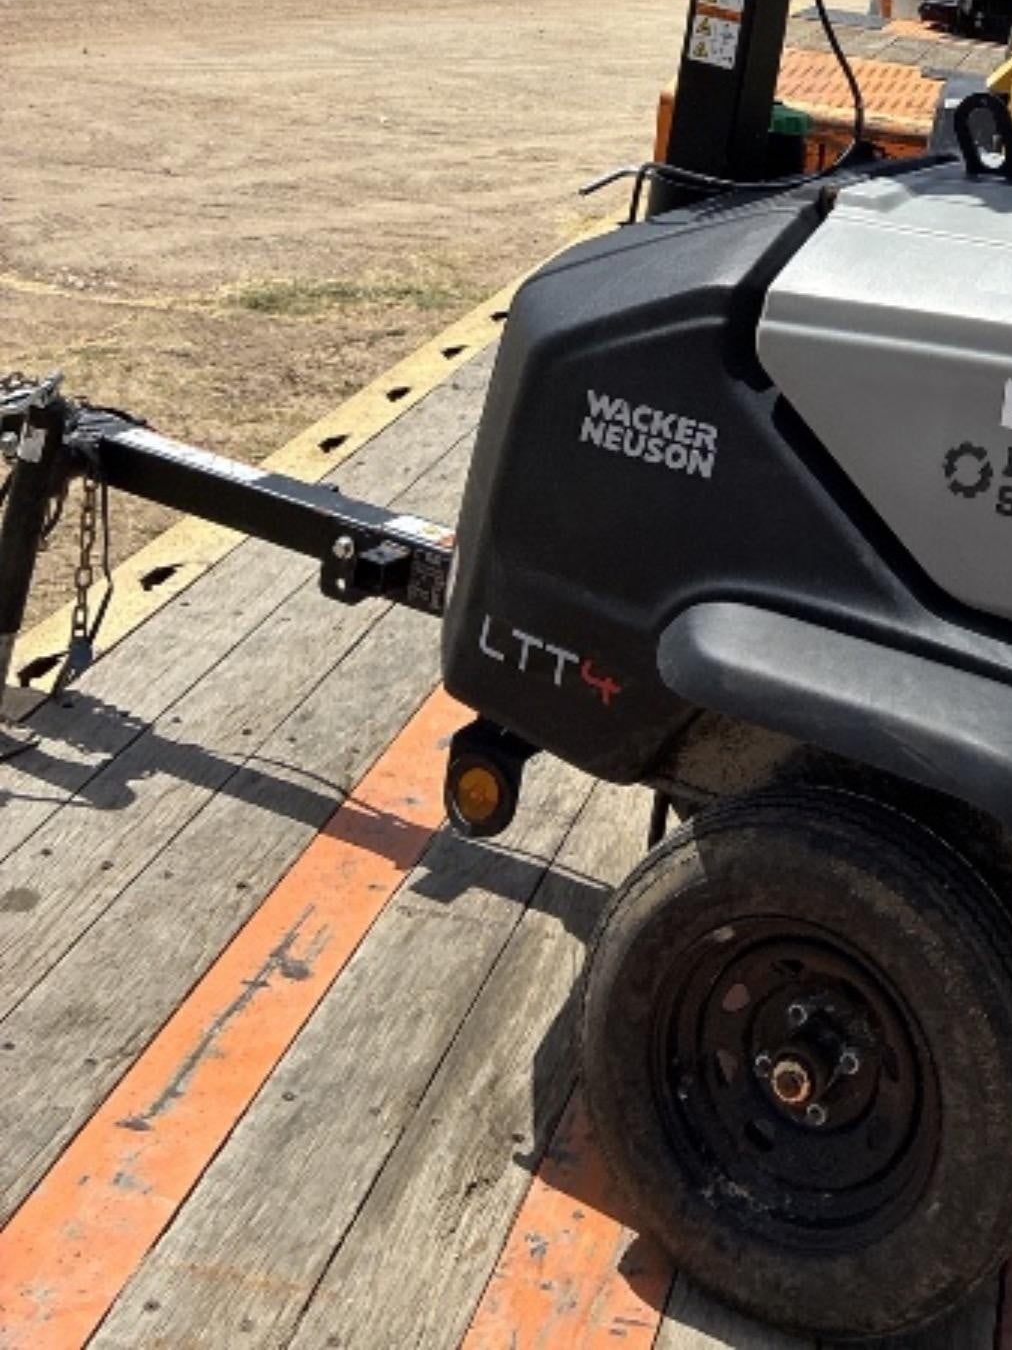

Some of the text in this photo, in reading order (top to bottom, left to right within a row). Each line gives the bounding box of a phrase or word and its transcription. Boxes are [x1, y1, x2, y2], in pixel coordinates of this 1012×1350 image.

[580, 415, 715, 478] NEUSON
[586, 389, 718, 452] WACKER
[478, 614, 622, 706] LTT4
